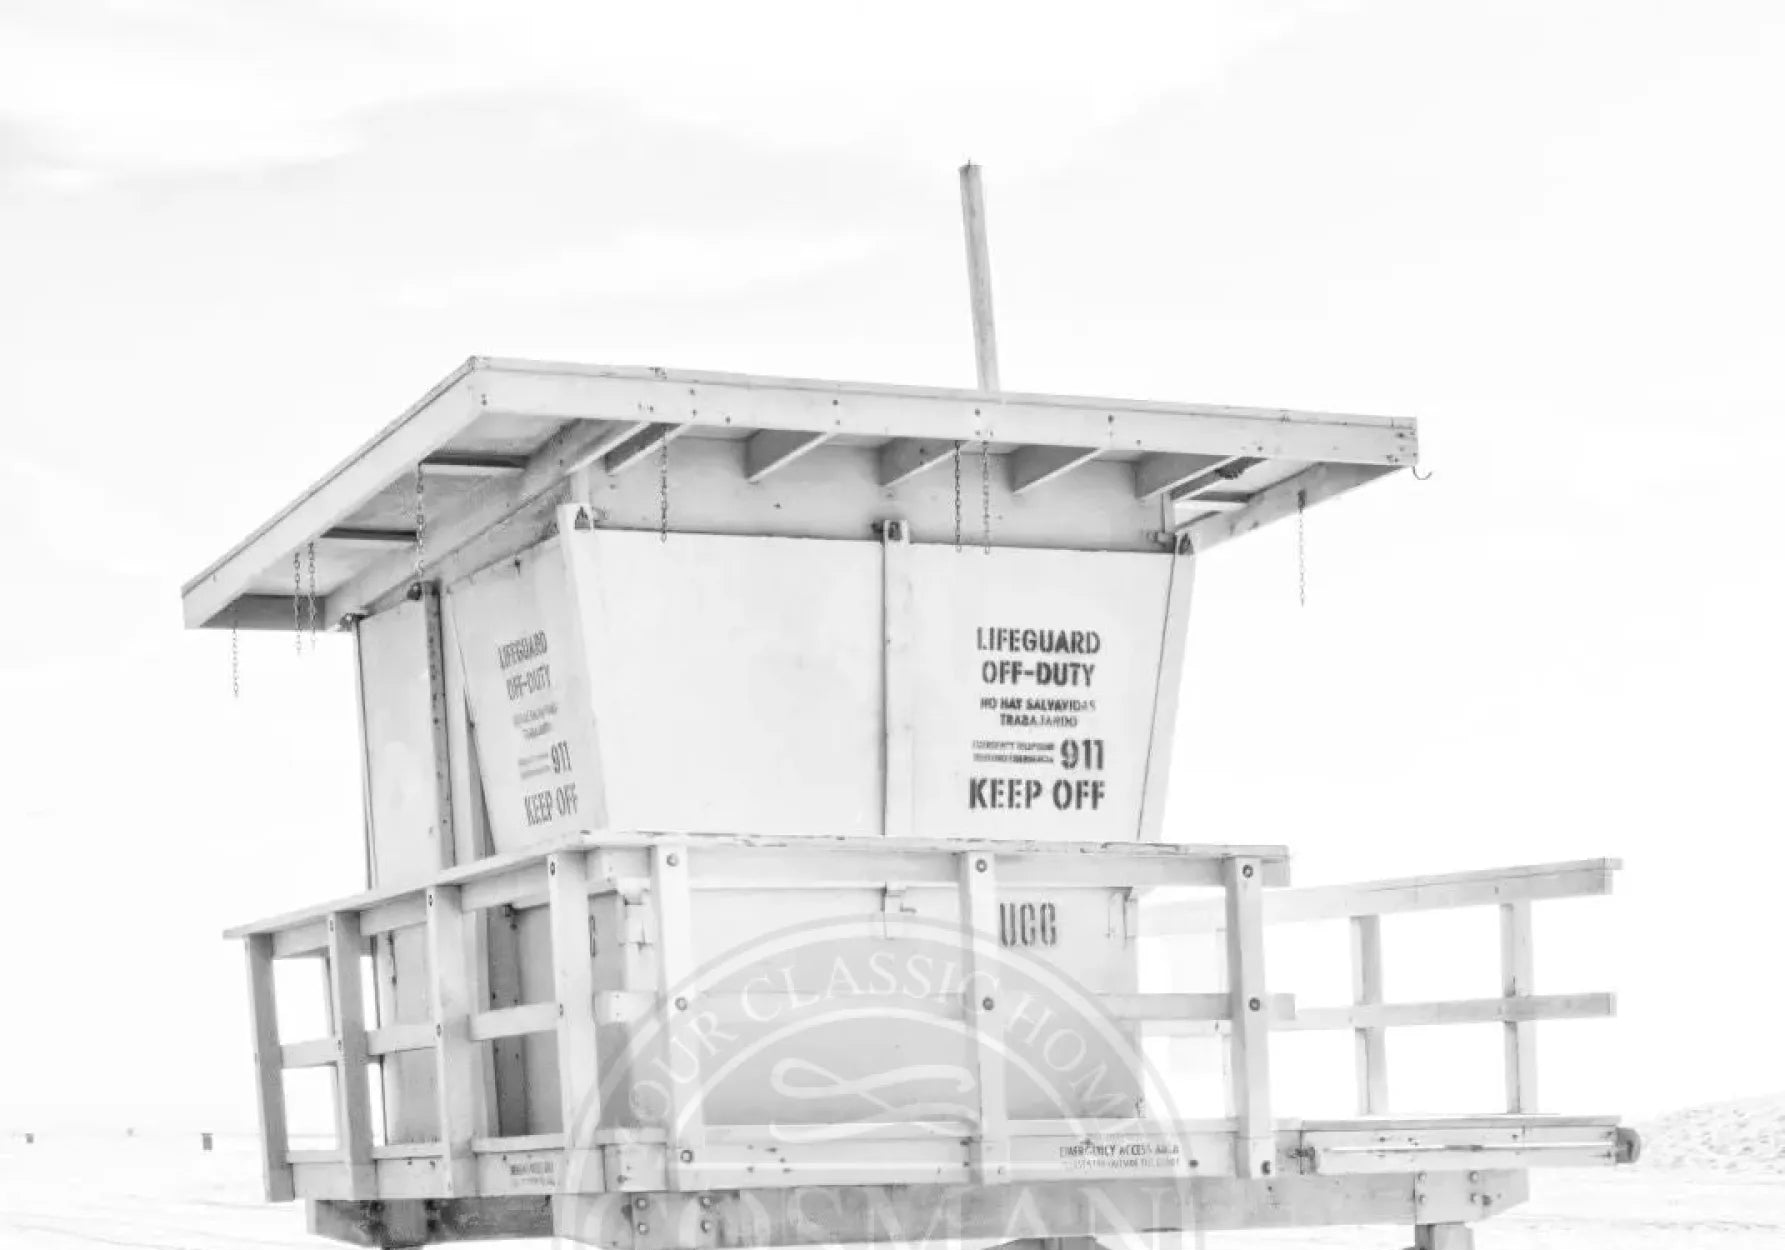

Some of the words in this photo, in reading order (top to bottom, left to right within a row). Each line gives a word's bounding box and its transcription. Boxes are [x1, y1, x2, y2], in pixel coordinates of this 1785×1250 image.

[498, 629, 547, 669] LIFEGUARD
[977, 627, 1100, 654] LIFEGUARD
[507, 664, 550, 700] OFF-DUTY
[982, 660, 1095, 686] OFF-DUTY
[551, 740, 572, 773] 911
[1060, 739, 1104, 770] 911
[525, 790, 552, 826] KEEP
[556, 783, 578, 816] OFF
[969, 778, 1043, 808] KEEP
[1053, 780, 1105, 810] OFF
